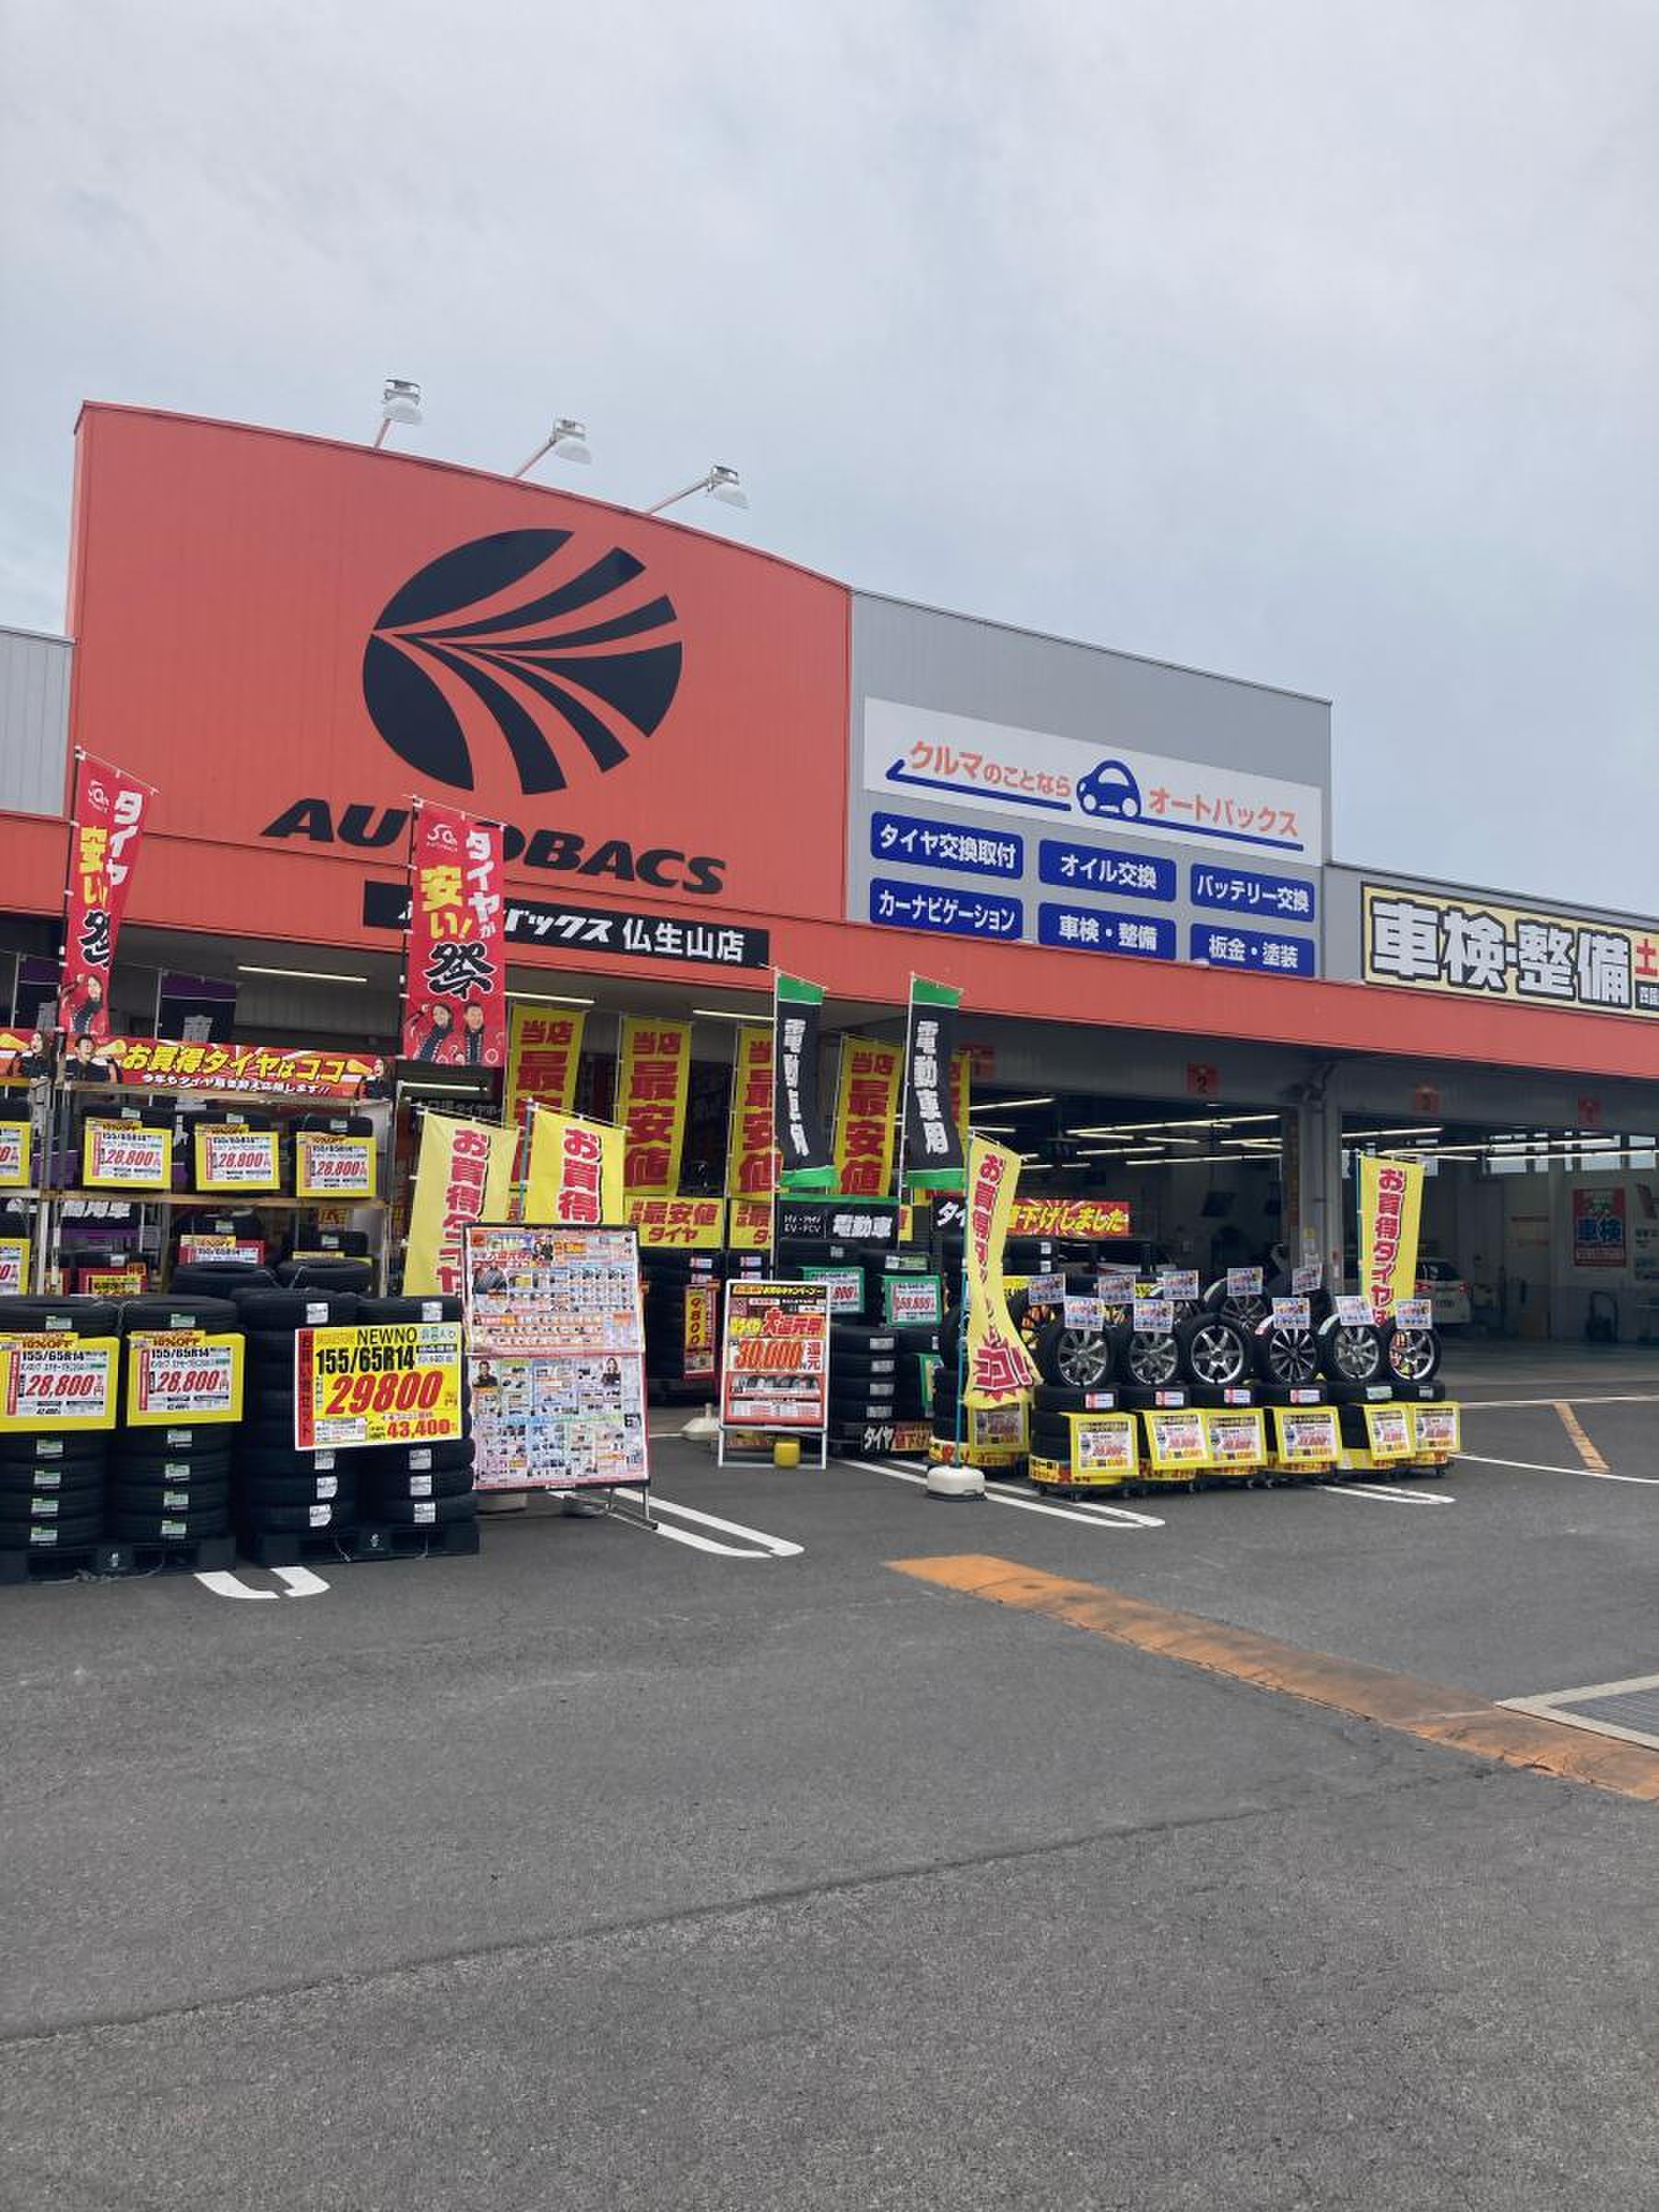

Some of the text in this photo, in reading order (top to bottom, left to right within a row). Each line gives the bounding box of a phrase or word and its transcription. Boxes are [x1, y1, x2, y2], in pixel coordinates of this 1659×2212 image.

[910, 740, 1299, 837] クルマのことなら オートバックス
[261, 798, 726, 893] AUBACS
[879, 823, 1016, 869] タイヤ交換取付
[467, 830, 500, 938] タイヤが
[1061, 853, 1157, 890] オイル交換
[421, 865, 472, 938] 安い!
[878, 891, 1016, 931] カーナビゲーション
[1197, 875, 1310, 913] バッテリー交換
[622, 929, 745, 962] 仏生山店
[1059, 915, 1158, 952] 車検・整備
[1209, 935, 1299, 970] 板金・塗装
[424, 942, 496, 1002] 祭
[522, 1020, 571, 1044] 当店
[633, 1031, 681, 1055] 当店
[120, 1044, 345, 1083] お買得タイヤはココ
[852, 1051, 893, 1075] 当店
[913, 1020, 950, 1154] 電動車用
[625, 1060, 679, 1187] 最安値
[558, 1127, 602, 1223] お買得
[437, 1127, 488, 1294] お買得タ
[642, 1201, 719, 1226] 最安値
[833, 1214, 892, 1238] 電動車
[648, 1226, 699, 1242] タイヤ
[1371, 1168, 1405, 1325] お買得タイヤは
[357, 1326, 418, 1346] NEWNO
[316, 1346, 415, 1374] 155/65R14
[25, 1373, 95, 1398] 28,800
[157, 1371, 220, 1394] 28,800
[324, 1371, 443, 1414] 29800
[386, 1418, 452, 1439] 43,400
